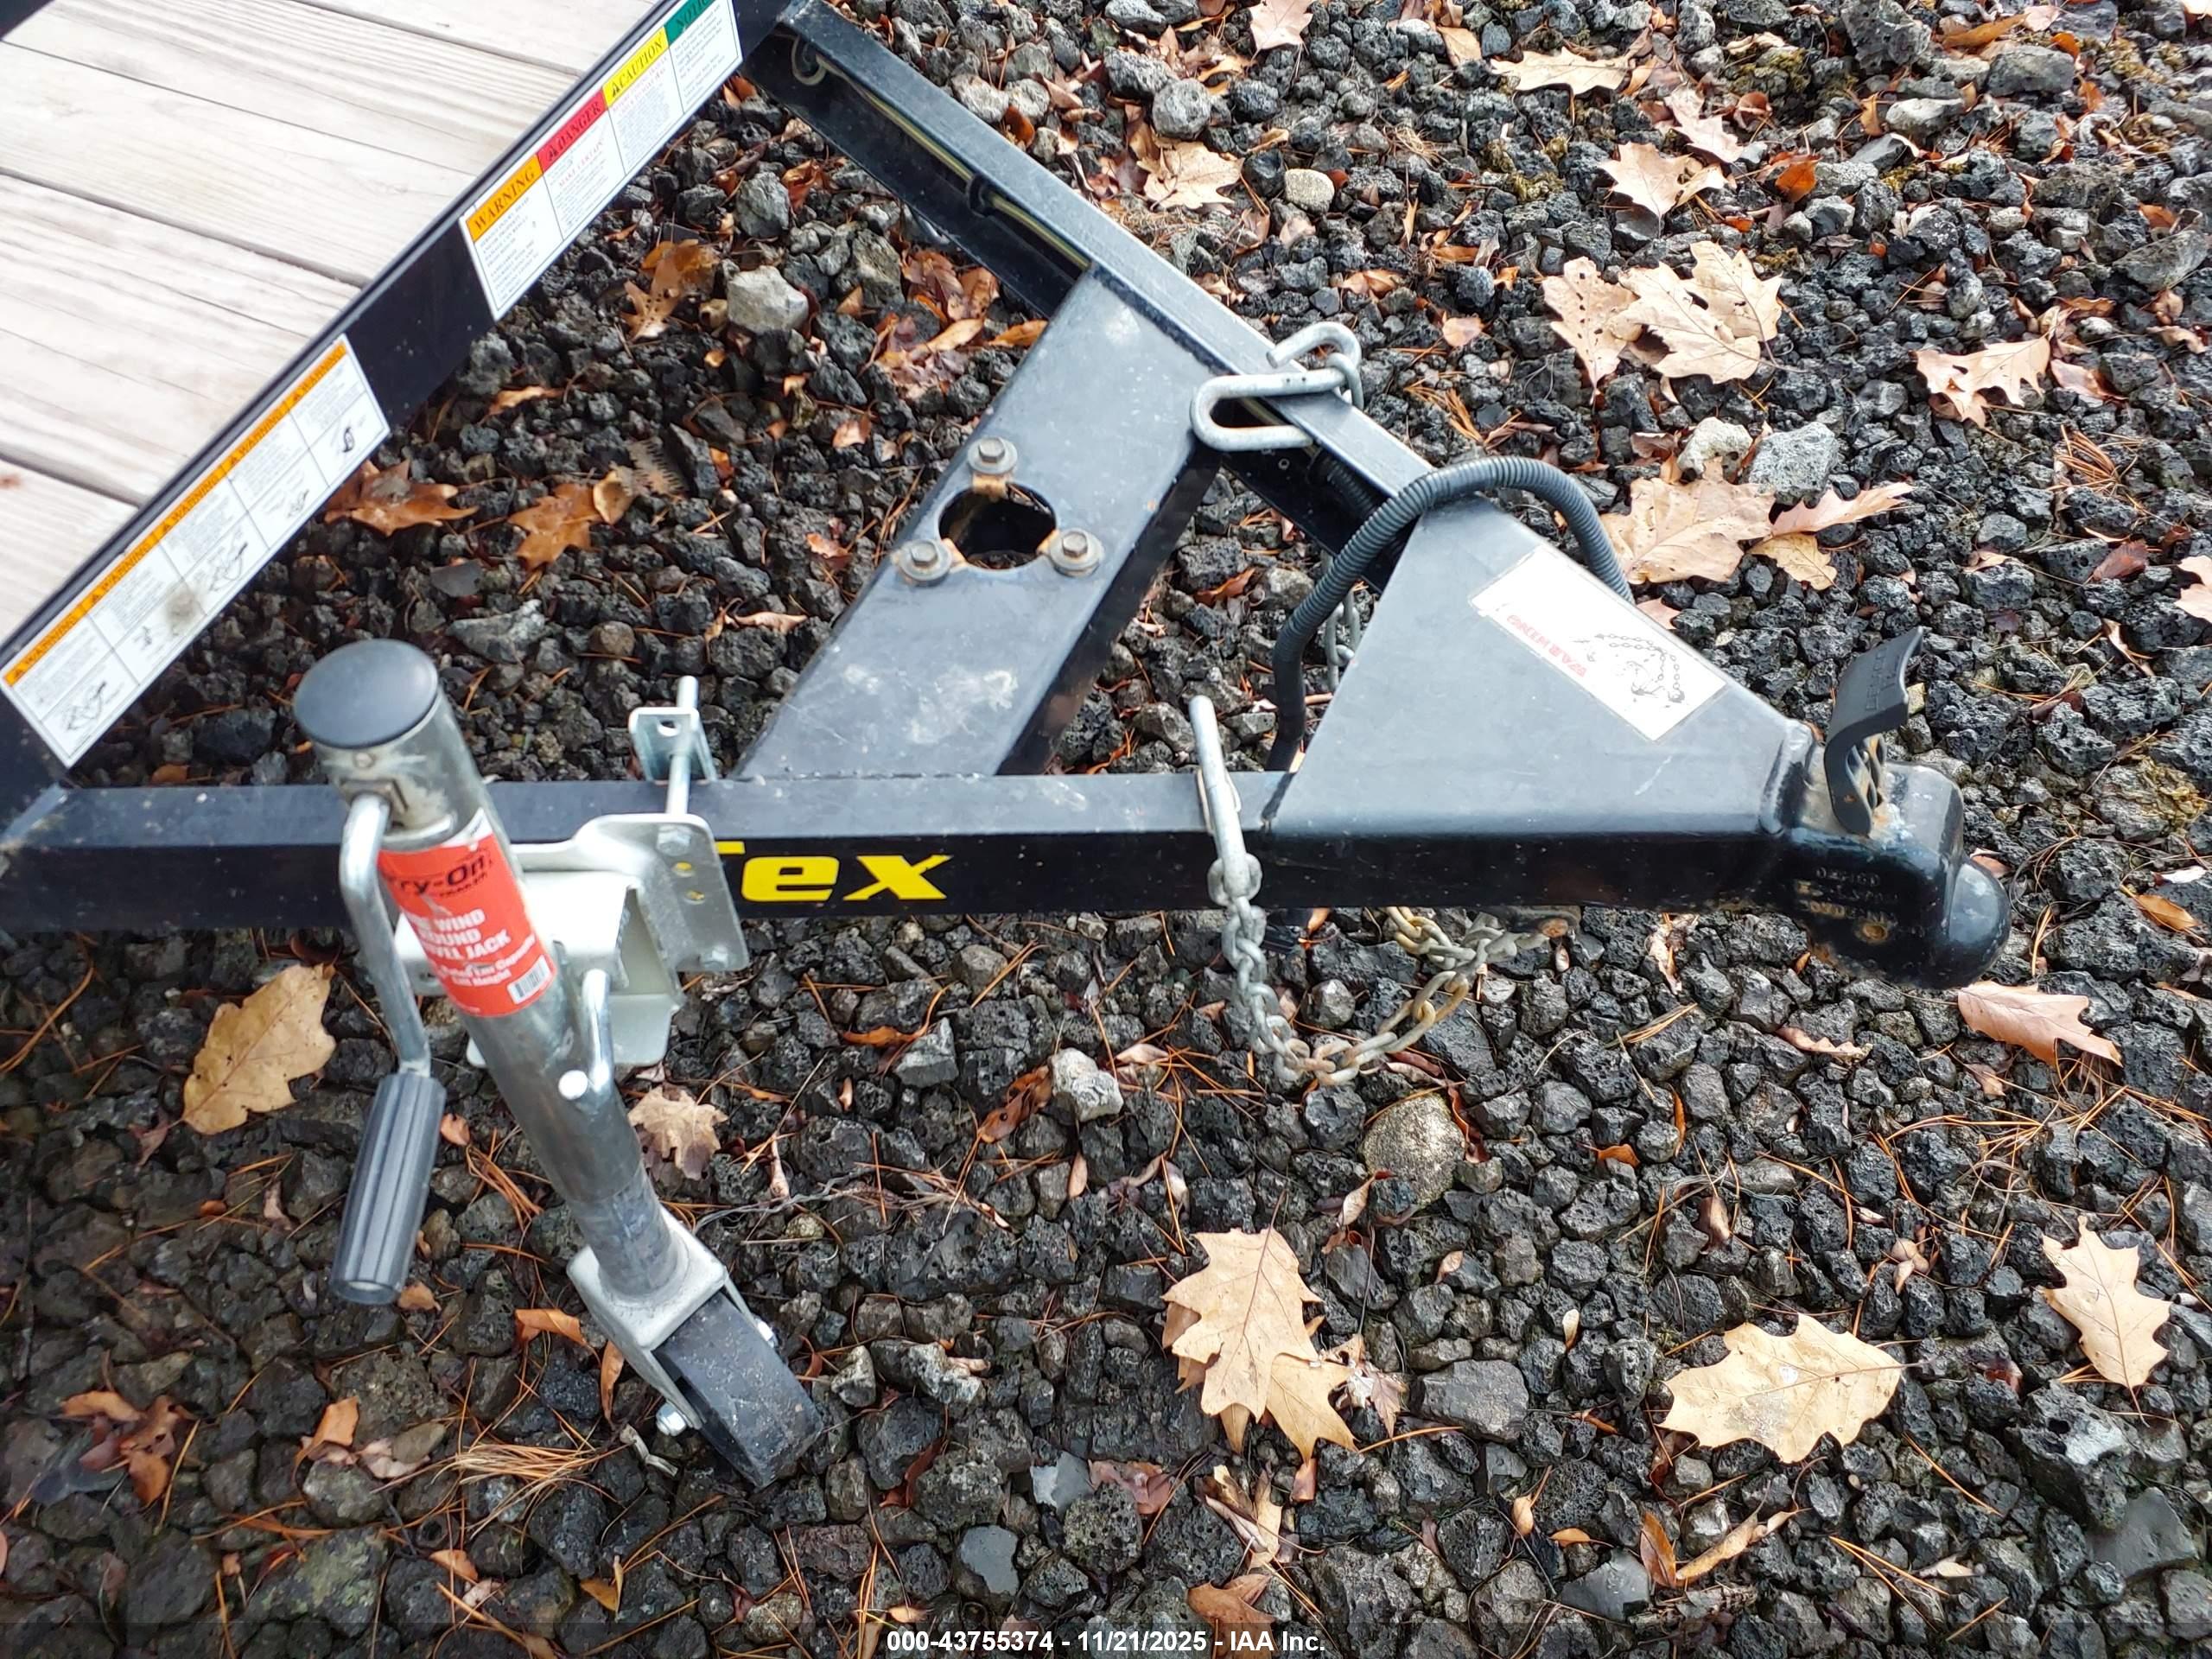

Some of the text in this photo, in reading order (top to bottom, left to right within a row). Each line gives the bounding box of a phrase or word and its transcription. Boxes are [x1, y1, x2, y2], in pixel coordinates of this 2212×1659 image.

[620, 37, 663, 88] CAUTION
[556, 101, 602, 149] DANGER
[474, 166, 535, 231] WARNING
[434, 909, 485, 931] WIND
[466, 929, 512, 960] JACK
